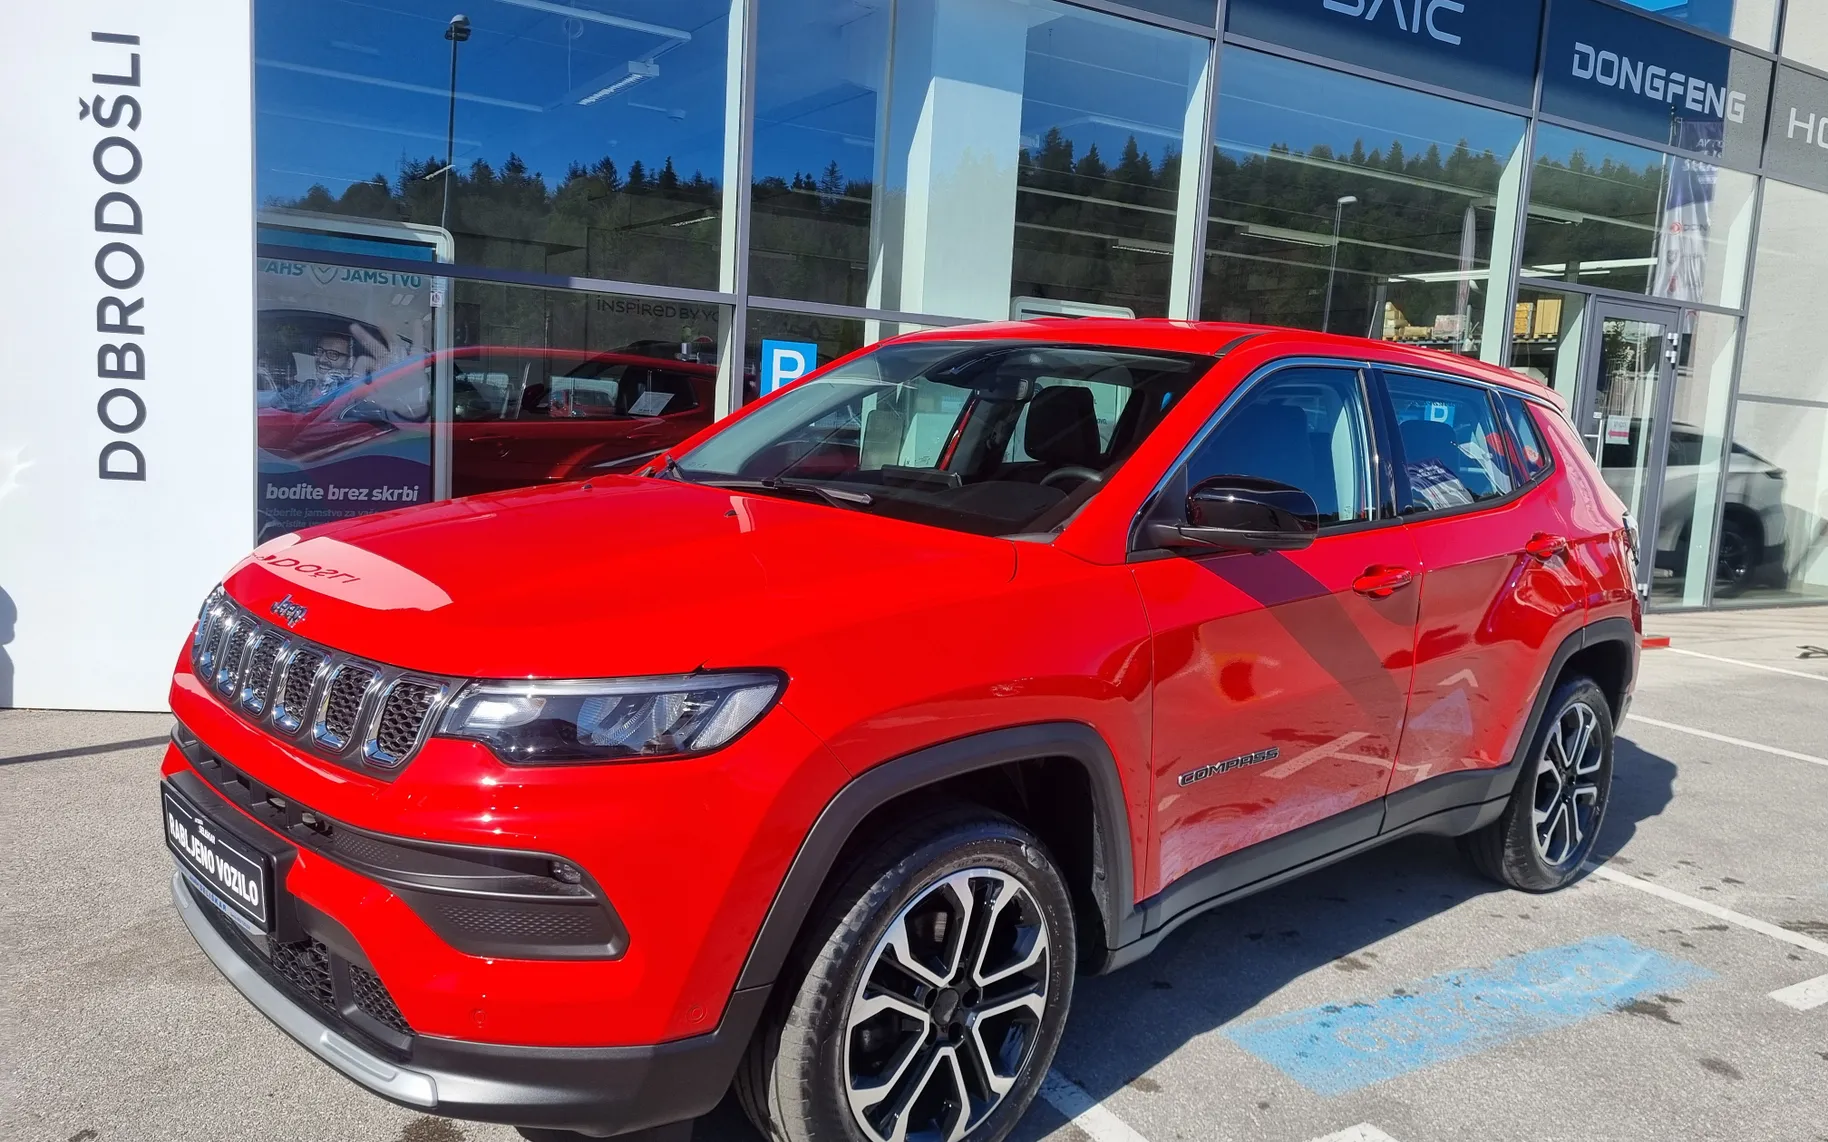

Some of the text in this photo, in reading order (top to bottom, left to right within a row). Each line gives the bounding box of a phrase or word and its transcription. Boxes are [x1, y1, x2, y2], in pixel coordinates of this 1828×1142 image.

[1571, 42, 1746, 124] DONGFENG
[79, 31, 147, 482] DOBRODOŠLI
[265, 260, 306, 277] AHS
[772, 348, 805, 392] P
[266, 483, 420, 502] bodite brez skrbi
[304, 507, 343, 518] jamstvo
[270, 594, 308, 628] Jeep
[1178, 747, 1280, 787] COMPASS
[169, 812, 259, 907] RABLJENO VOZILO
